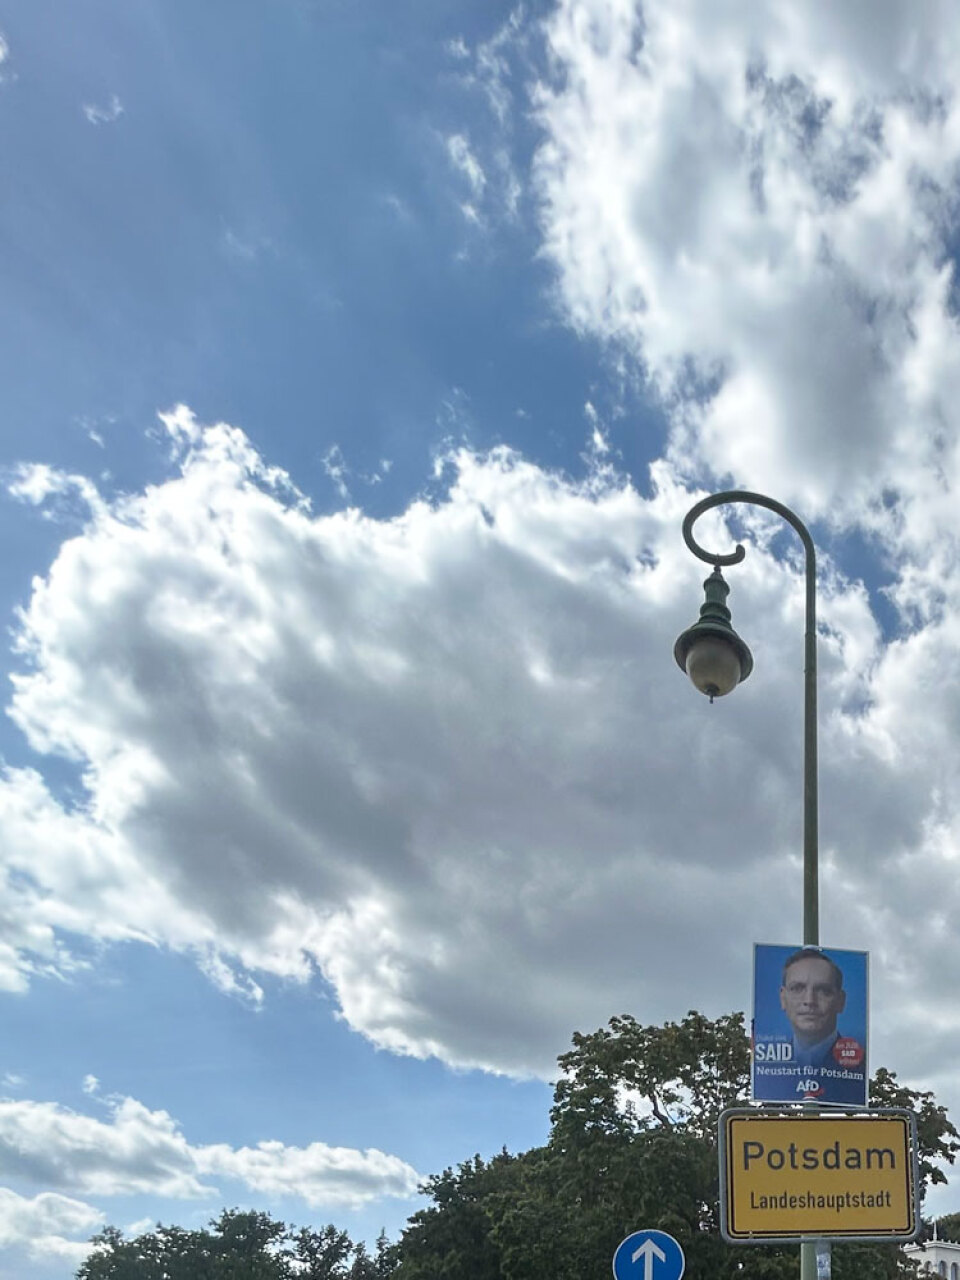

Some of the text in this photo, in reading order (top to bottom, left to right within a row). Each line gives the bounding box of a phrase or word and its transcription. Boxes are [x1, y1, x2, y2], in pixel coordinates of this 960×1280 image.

[755, 1043, 792, 1061] SAID
[756, 1065, 864, 1080] Neustart für Potsdam
[796, 1080, 820, 1093] AfD
[743, 1141, 896, 1171] Potsdam
[750, 1190, 892, 1213] Landeshauptstadt
